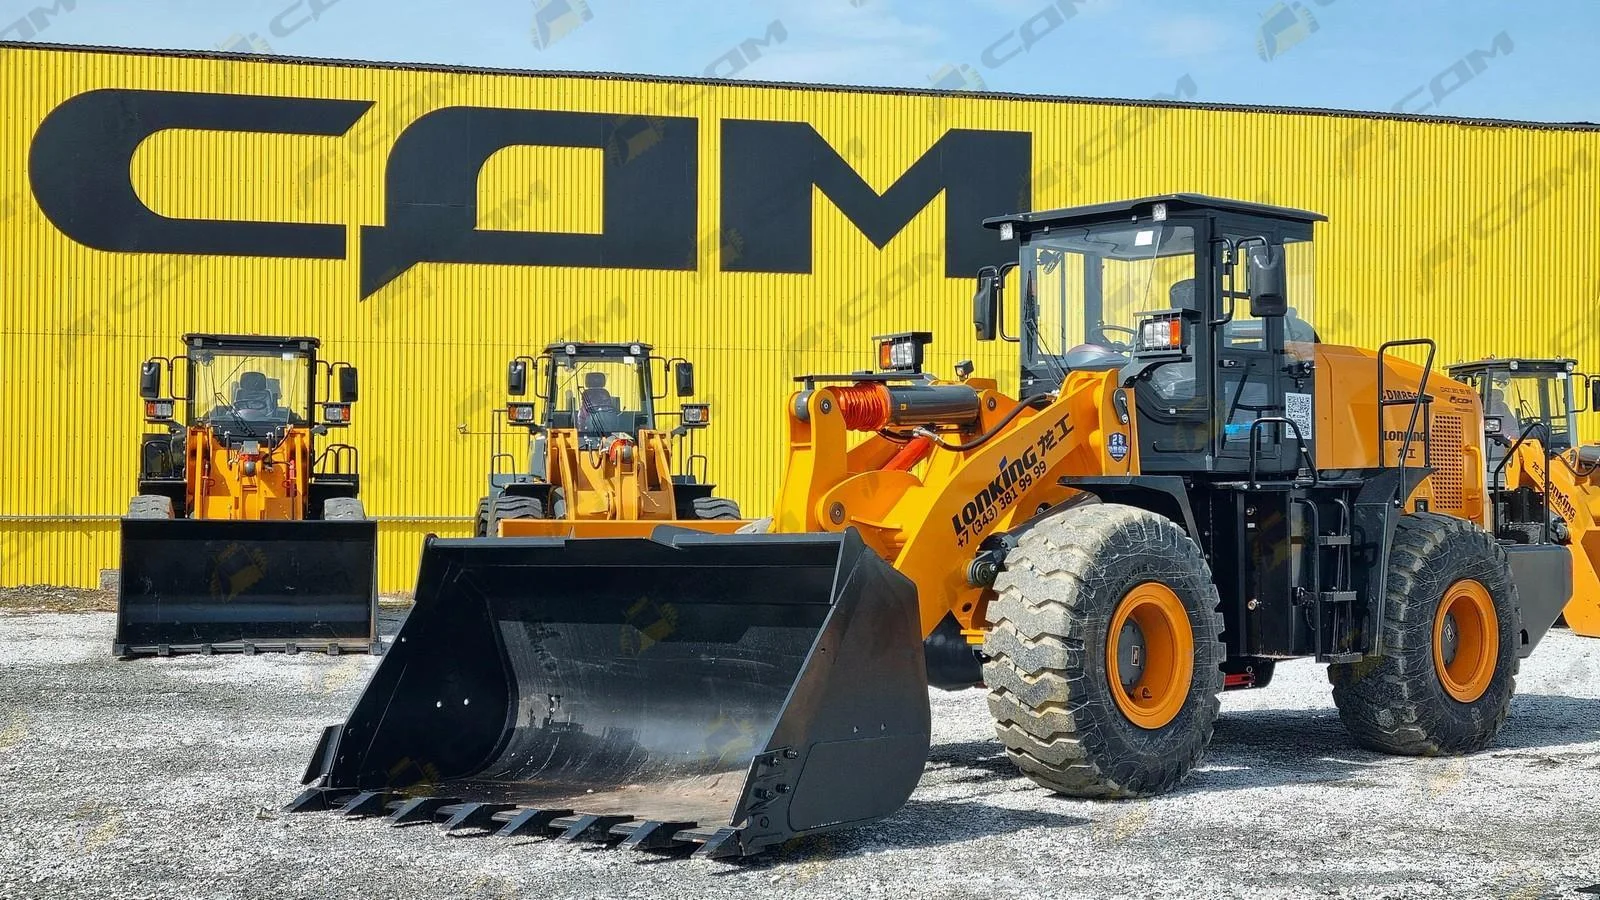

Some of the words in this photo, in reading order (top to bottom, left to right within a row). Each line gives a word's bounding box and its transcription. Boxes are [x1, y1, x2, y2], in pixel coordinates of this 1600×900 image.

[1383, 389, 1419, 400] DM85
[1037, 412, 1075, 457] 龙工
[957, 530, 970, 548] +7
[972, 506, 998, 536] (343)
[998, 487, 1019, 510] 381
[1018, 473, 1033, 492] 99
[1033, 460, 1047, 479] 99
